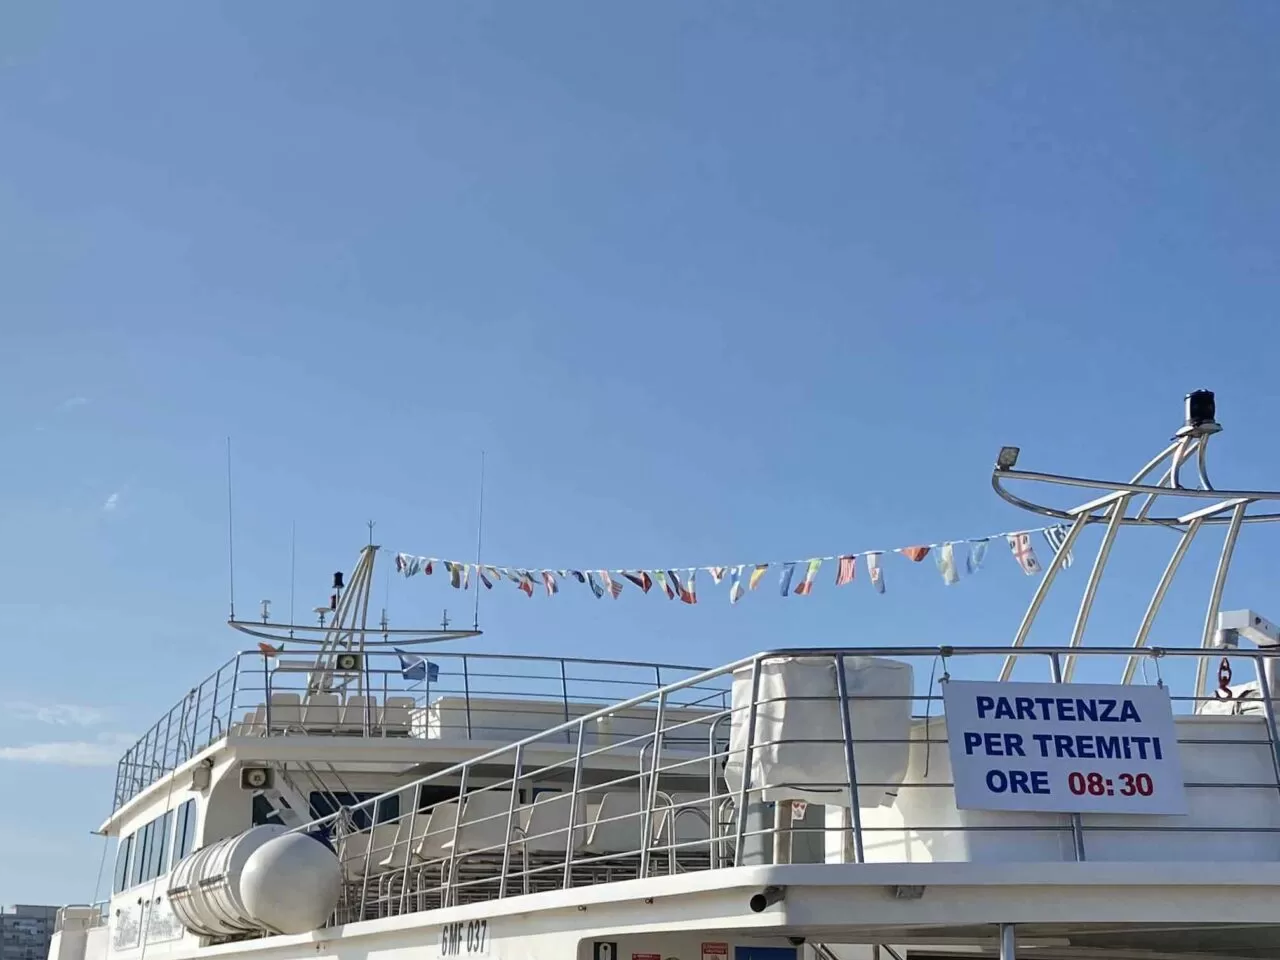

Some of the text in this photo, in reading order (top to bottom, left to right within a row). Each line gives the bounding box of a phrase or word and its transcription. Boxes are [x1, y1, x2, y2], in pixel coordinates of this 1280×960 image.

[976, 695, 1142, 723] PARTENZA
[964, 732, 1163, 760] PER TREMITI
[986, 769, 1154, 797] ORE 08:30
[467, 919, 487, 953] 037
